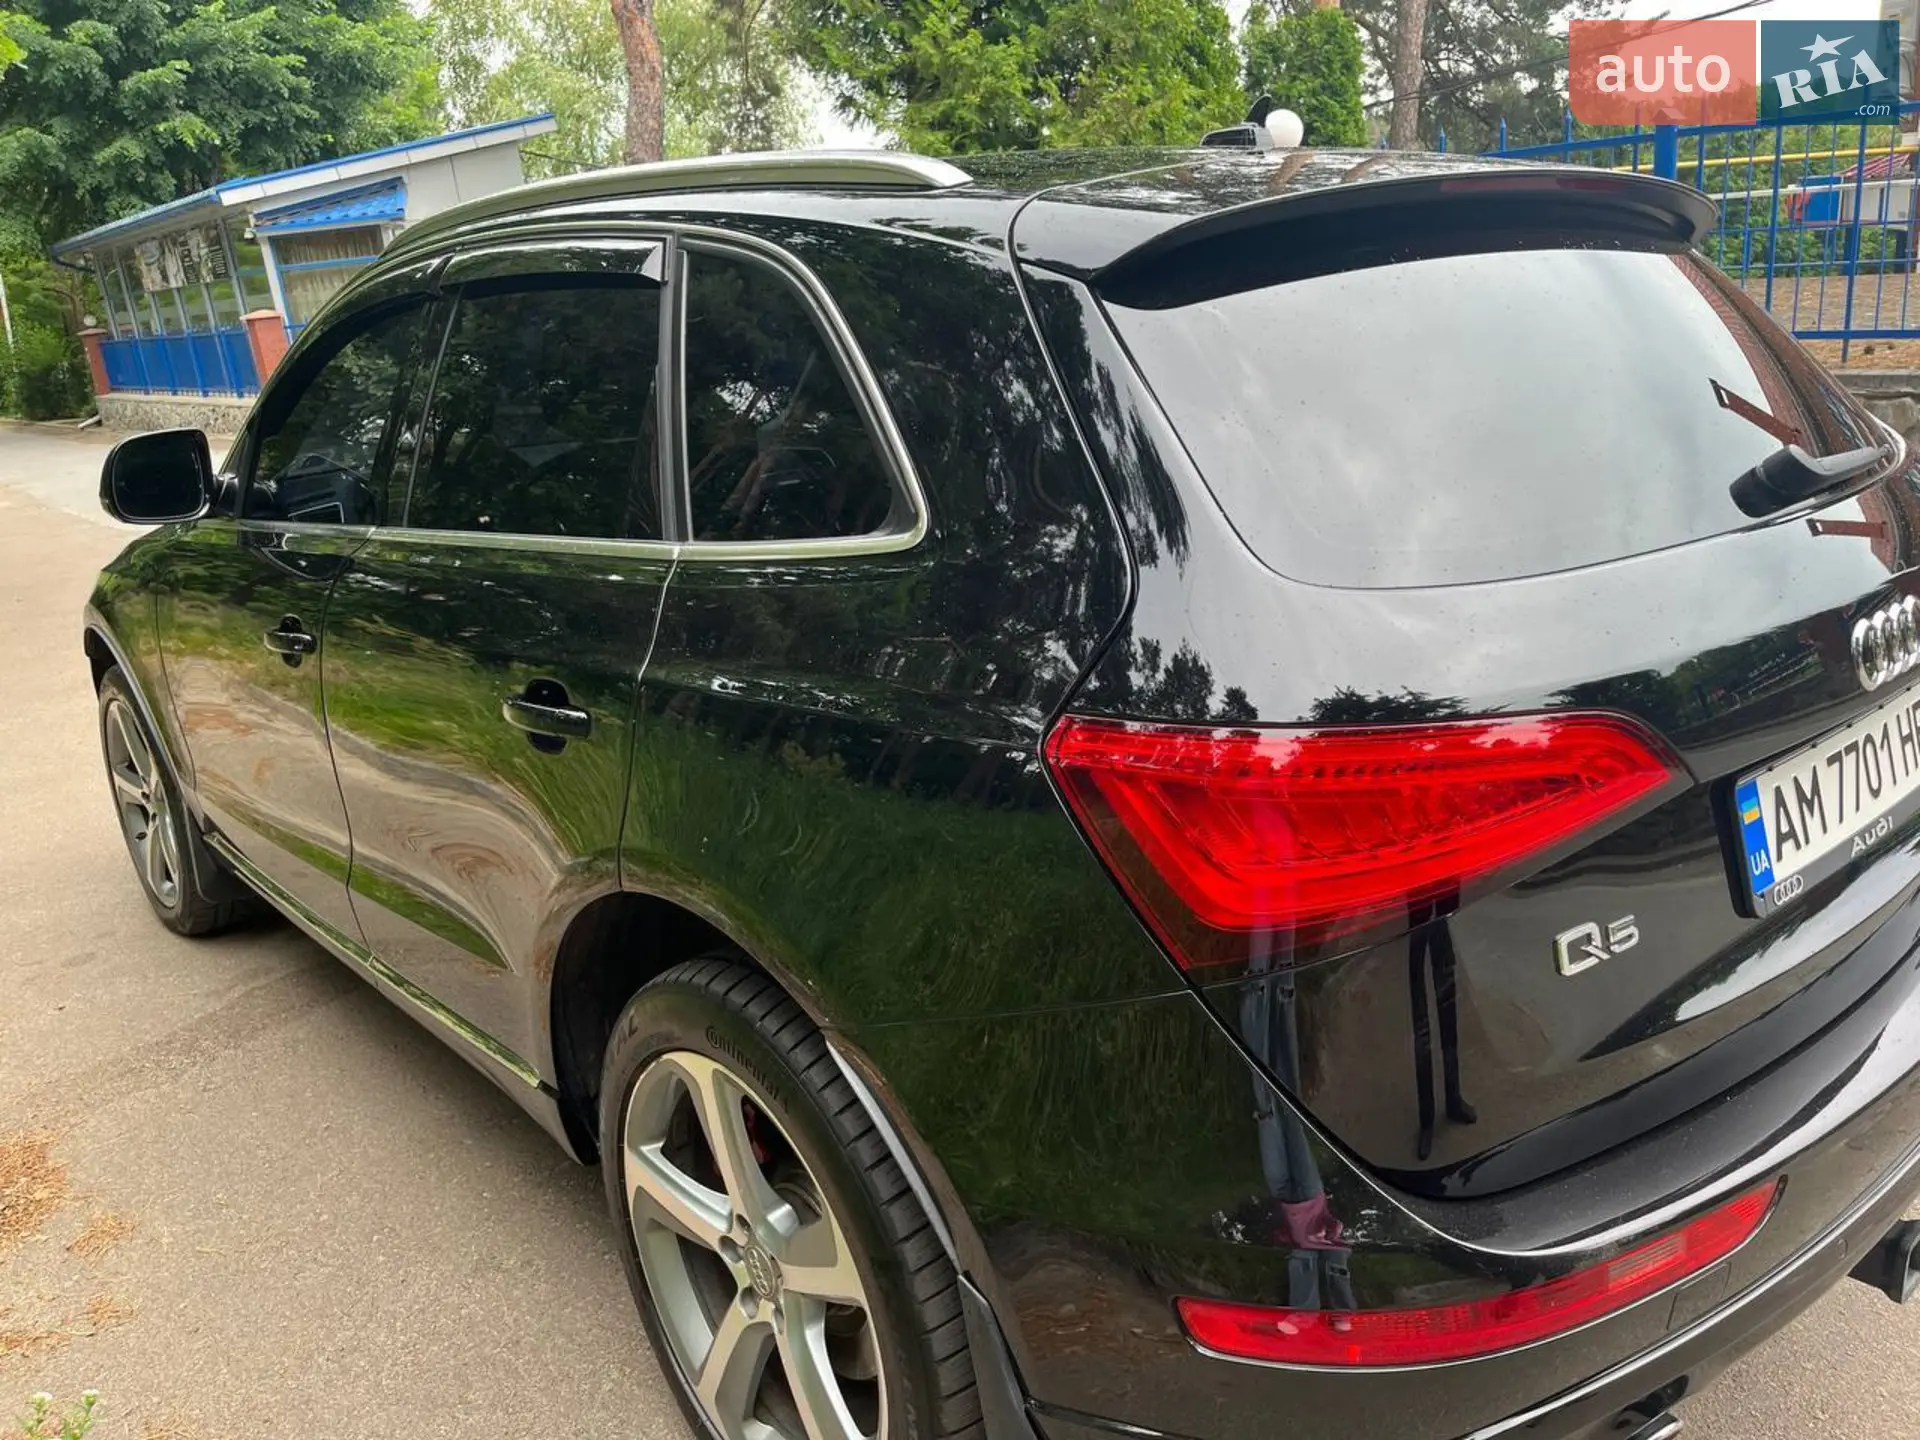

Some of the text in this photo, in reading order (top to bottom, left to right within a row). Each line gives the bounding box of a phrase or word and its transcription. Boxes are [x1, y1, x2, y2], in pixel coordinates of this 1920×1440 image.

[1773, 764, 1828, 862] AM
[1826, 721, 1897, 824] 7701
[1750, 848, 1771, 876] UA
[1850, 815, 1894, 859] Audi
[1552, 914, 1640, 977] Q5
[706, 1025, 780, 1101] Continental
